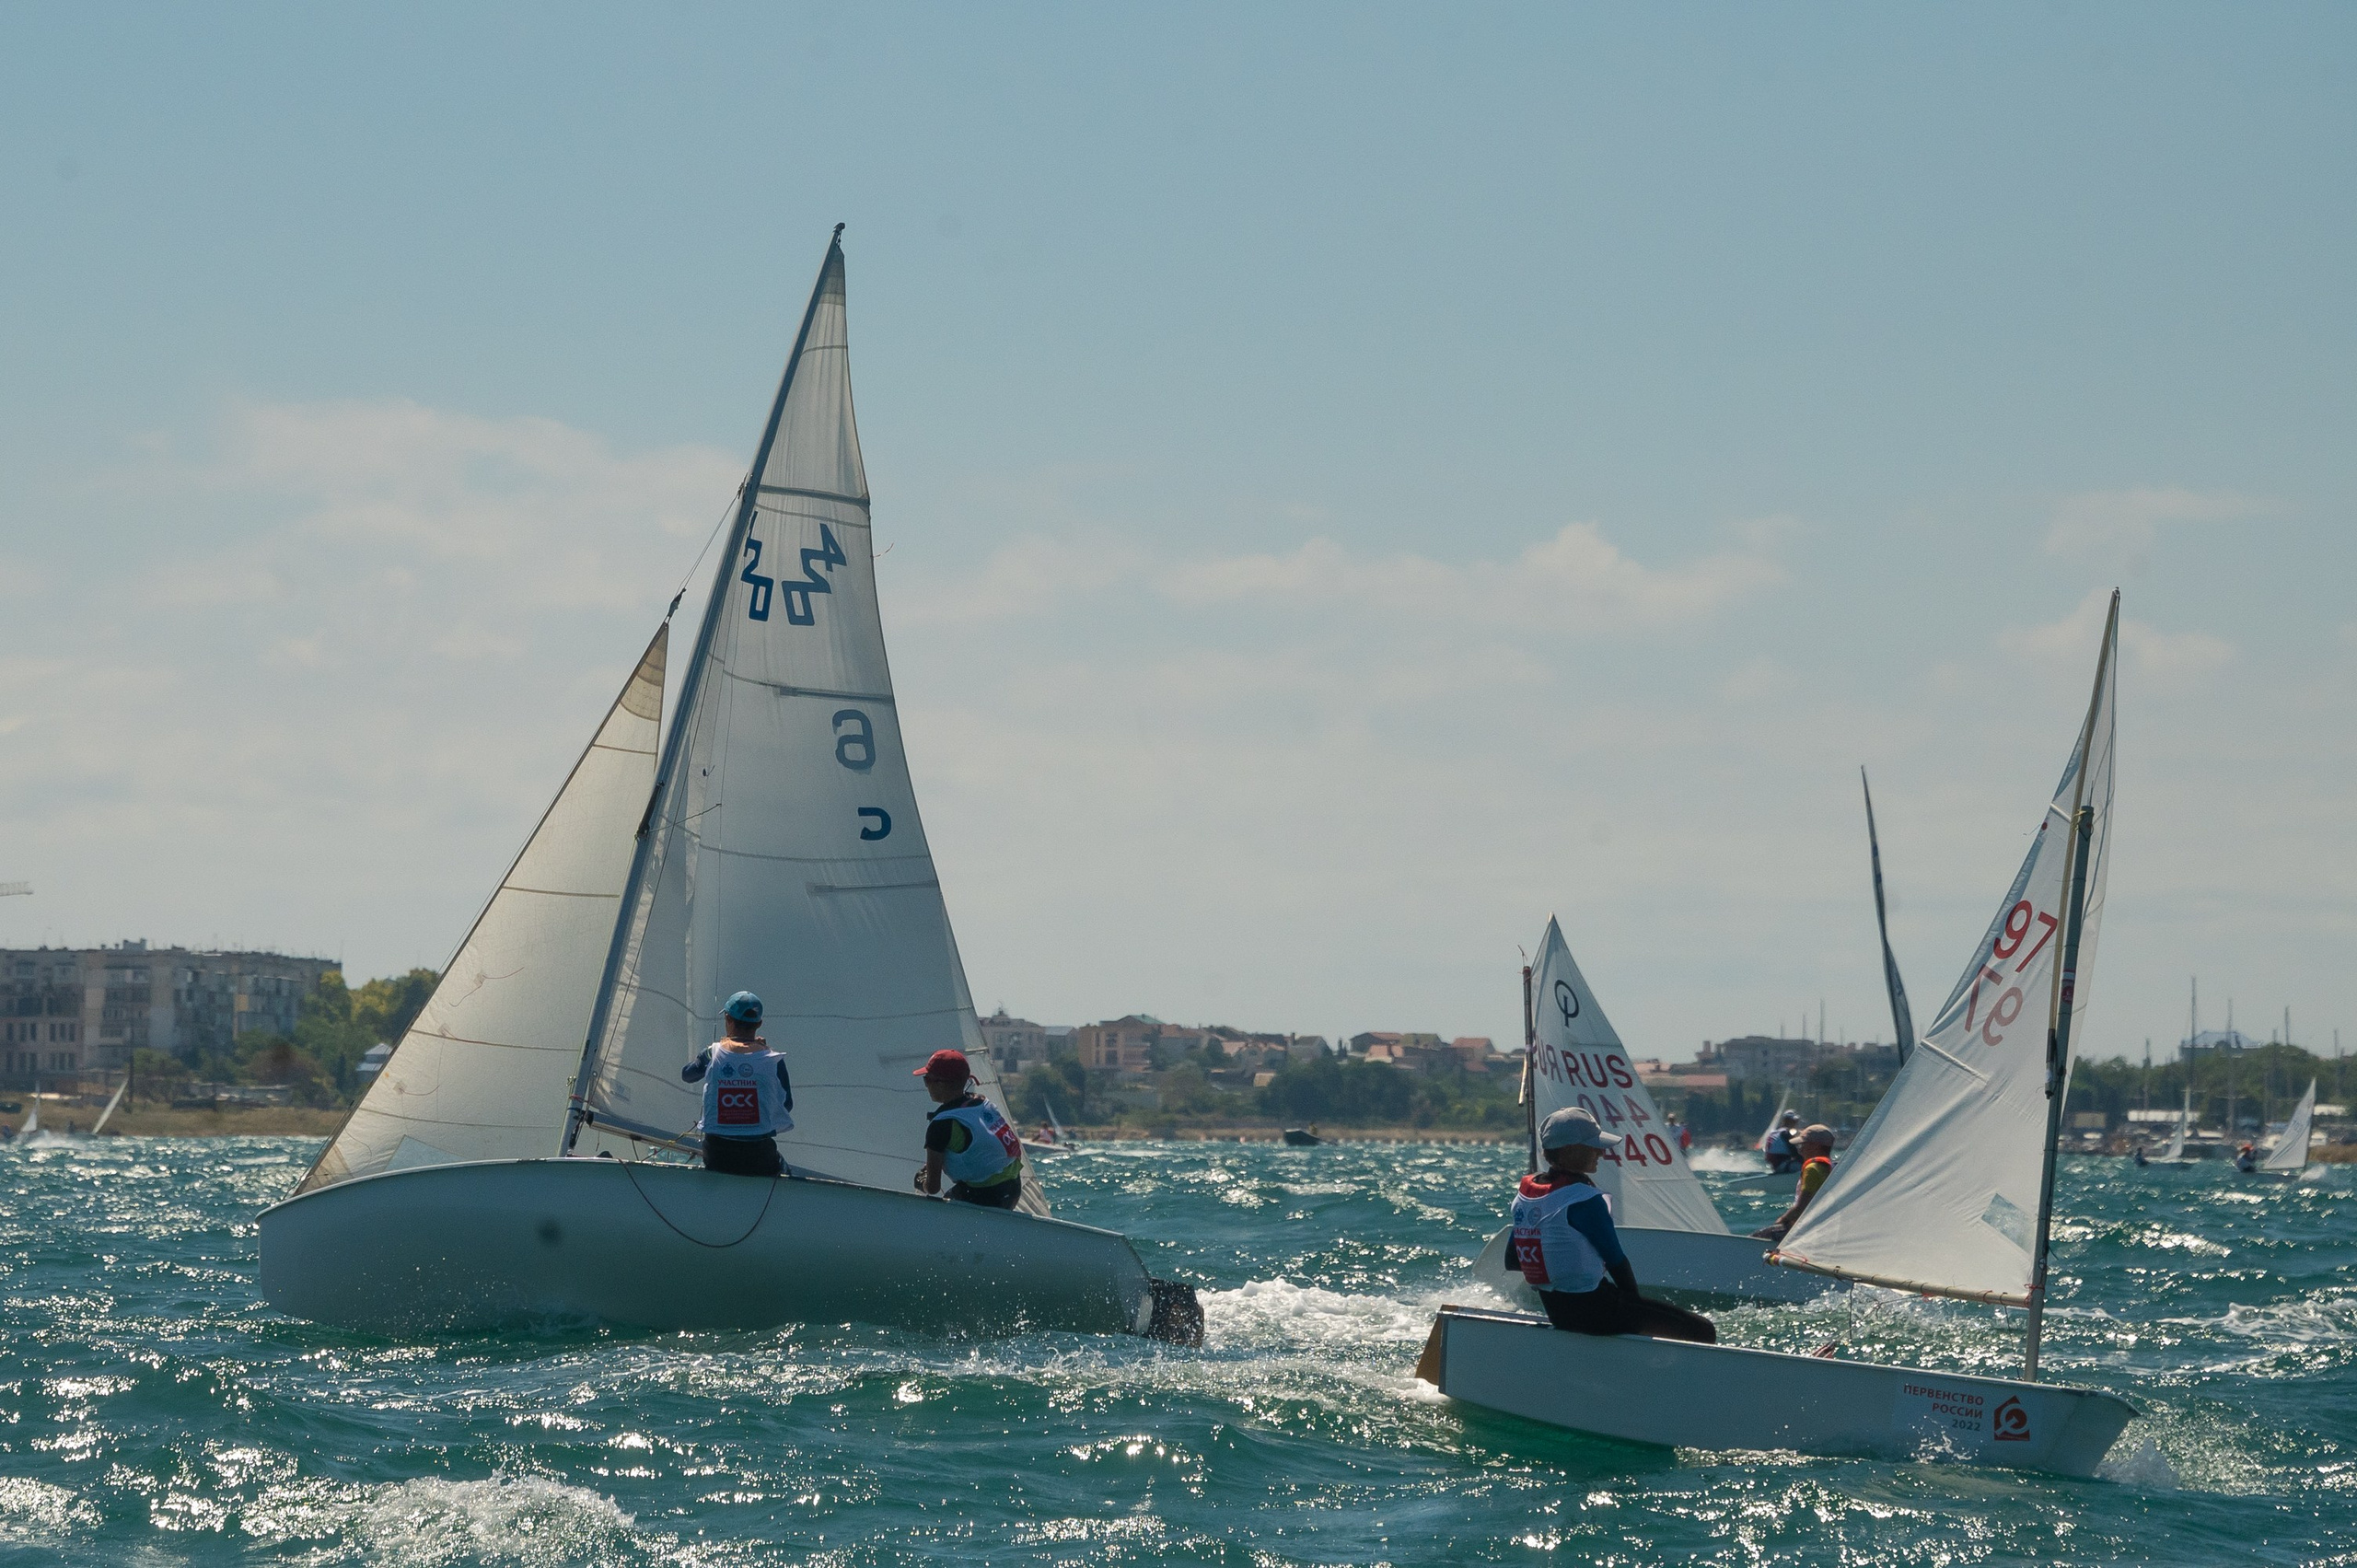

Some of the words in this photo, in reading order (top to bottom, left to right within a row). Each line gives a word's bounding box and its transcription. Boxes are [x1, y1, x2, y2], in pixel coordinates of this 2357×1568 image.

[741, 510, 774, 622] 20
[1561, 1050, 1633, 1089] RUS
[1903, 1384, 1984, 1406] ПЕРВЕНСТВО
[1932, 1402, 1983, 1419] РОССИИ
[1952, 1419, 1981, 1432] 2022
